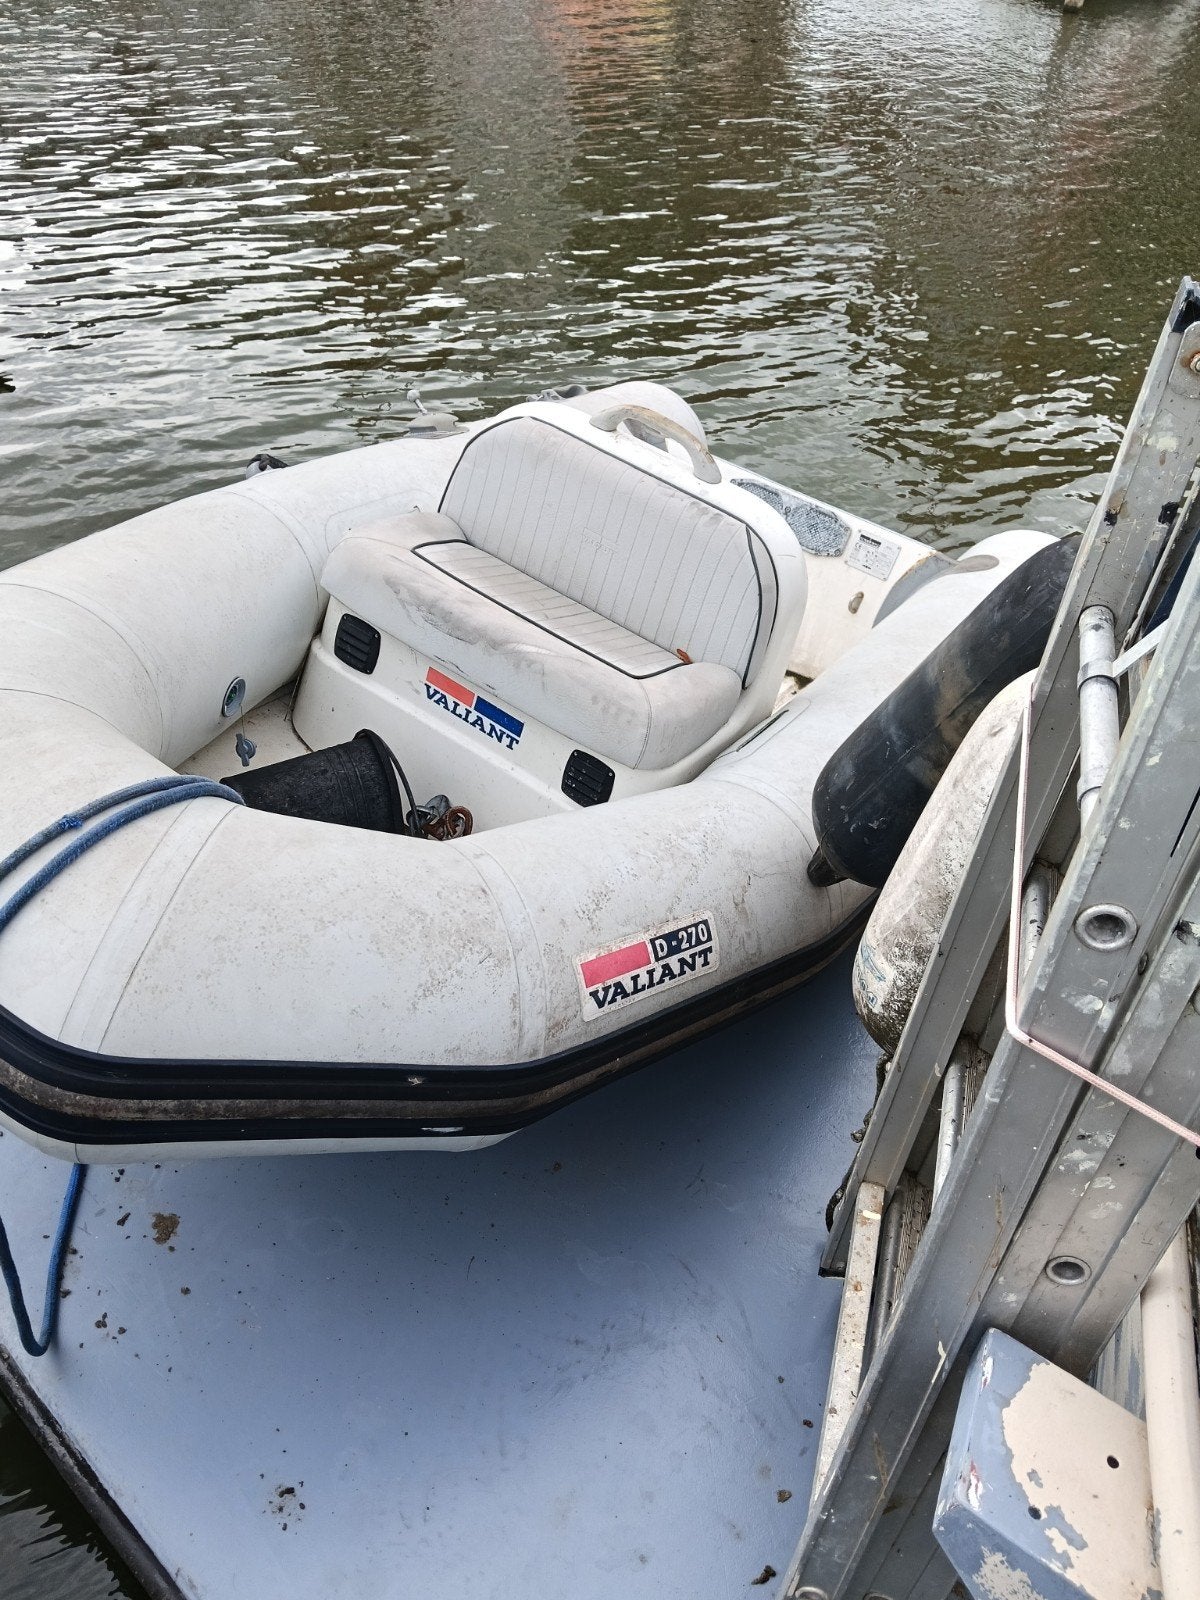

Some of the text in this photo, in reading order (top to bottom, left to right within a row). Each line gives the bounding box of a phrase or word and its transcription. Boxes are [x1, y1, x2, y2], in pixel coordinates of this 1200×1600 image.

[424, 683, 520, 750] VALIANT
[654, 923, 709, 958] D-270
[589, 946, 713, 1009] VALIANT
